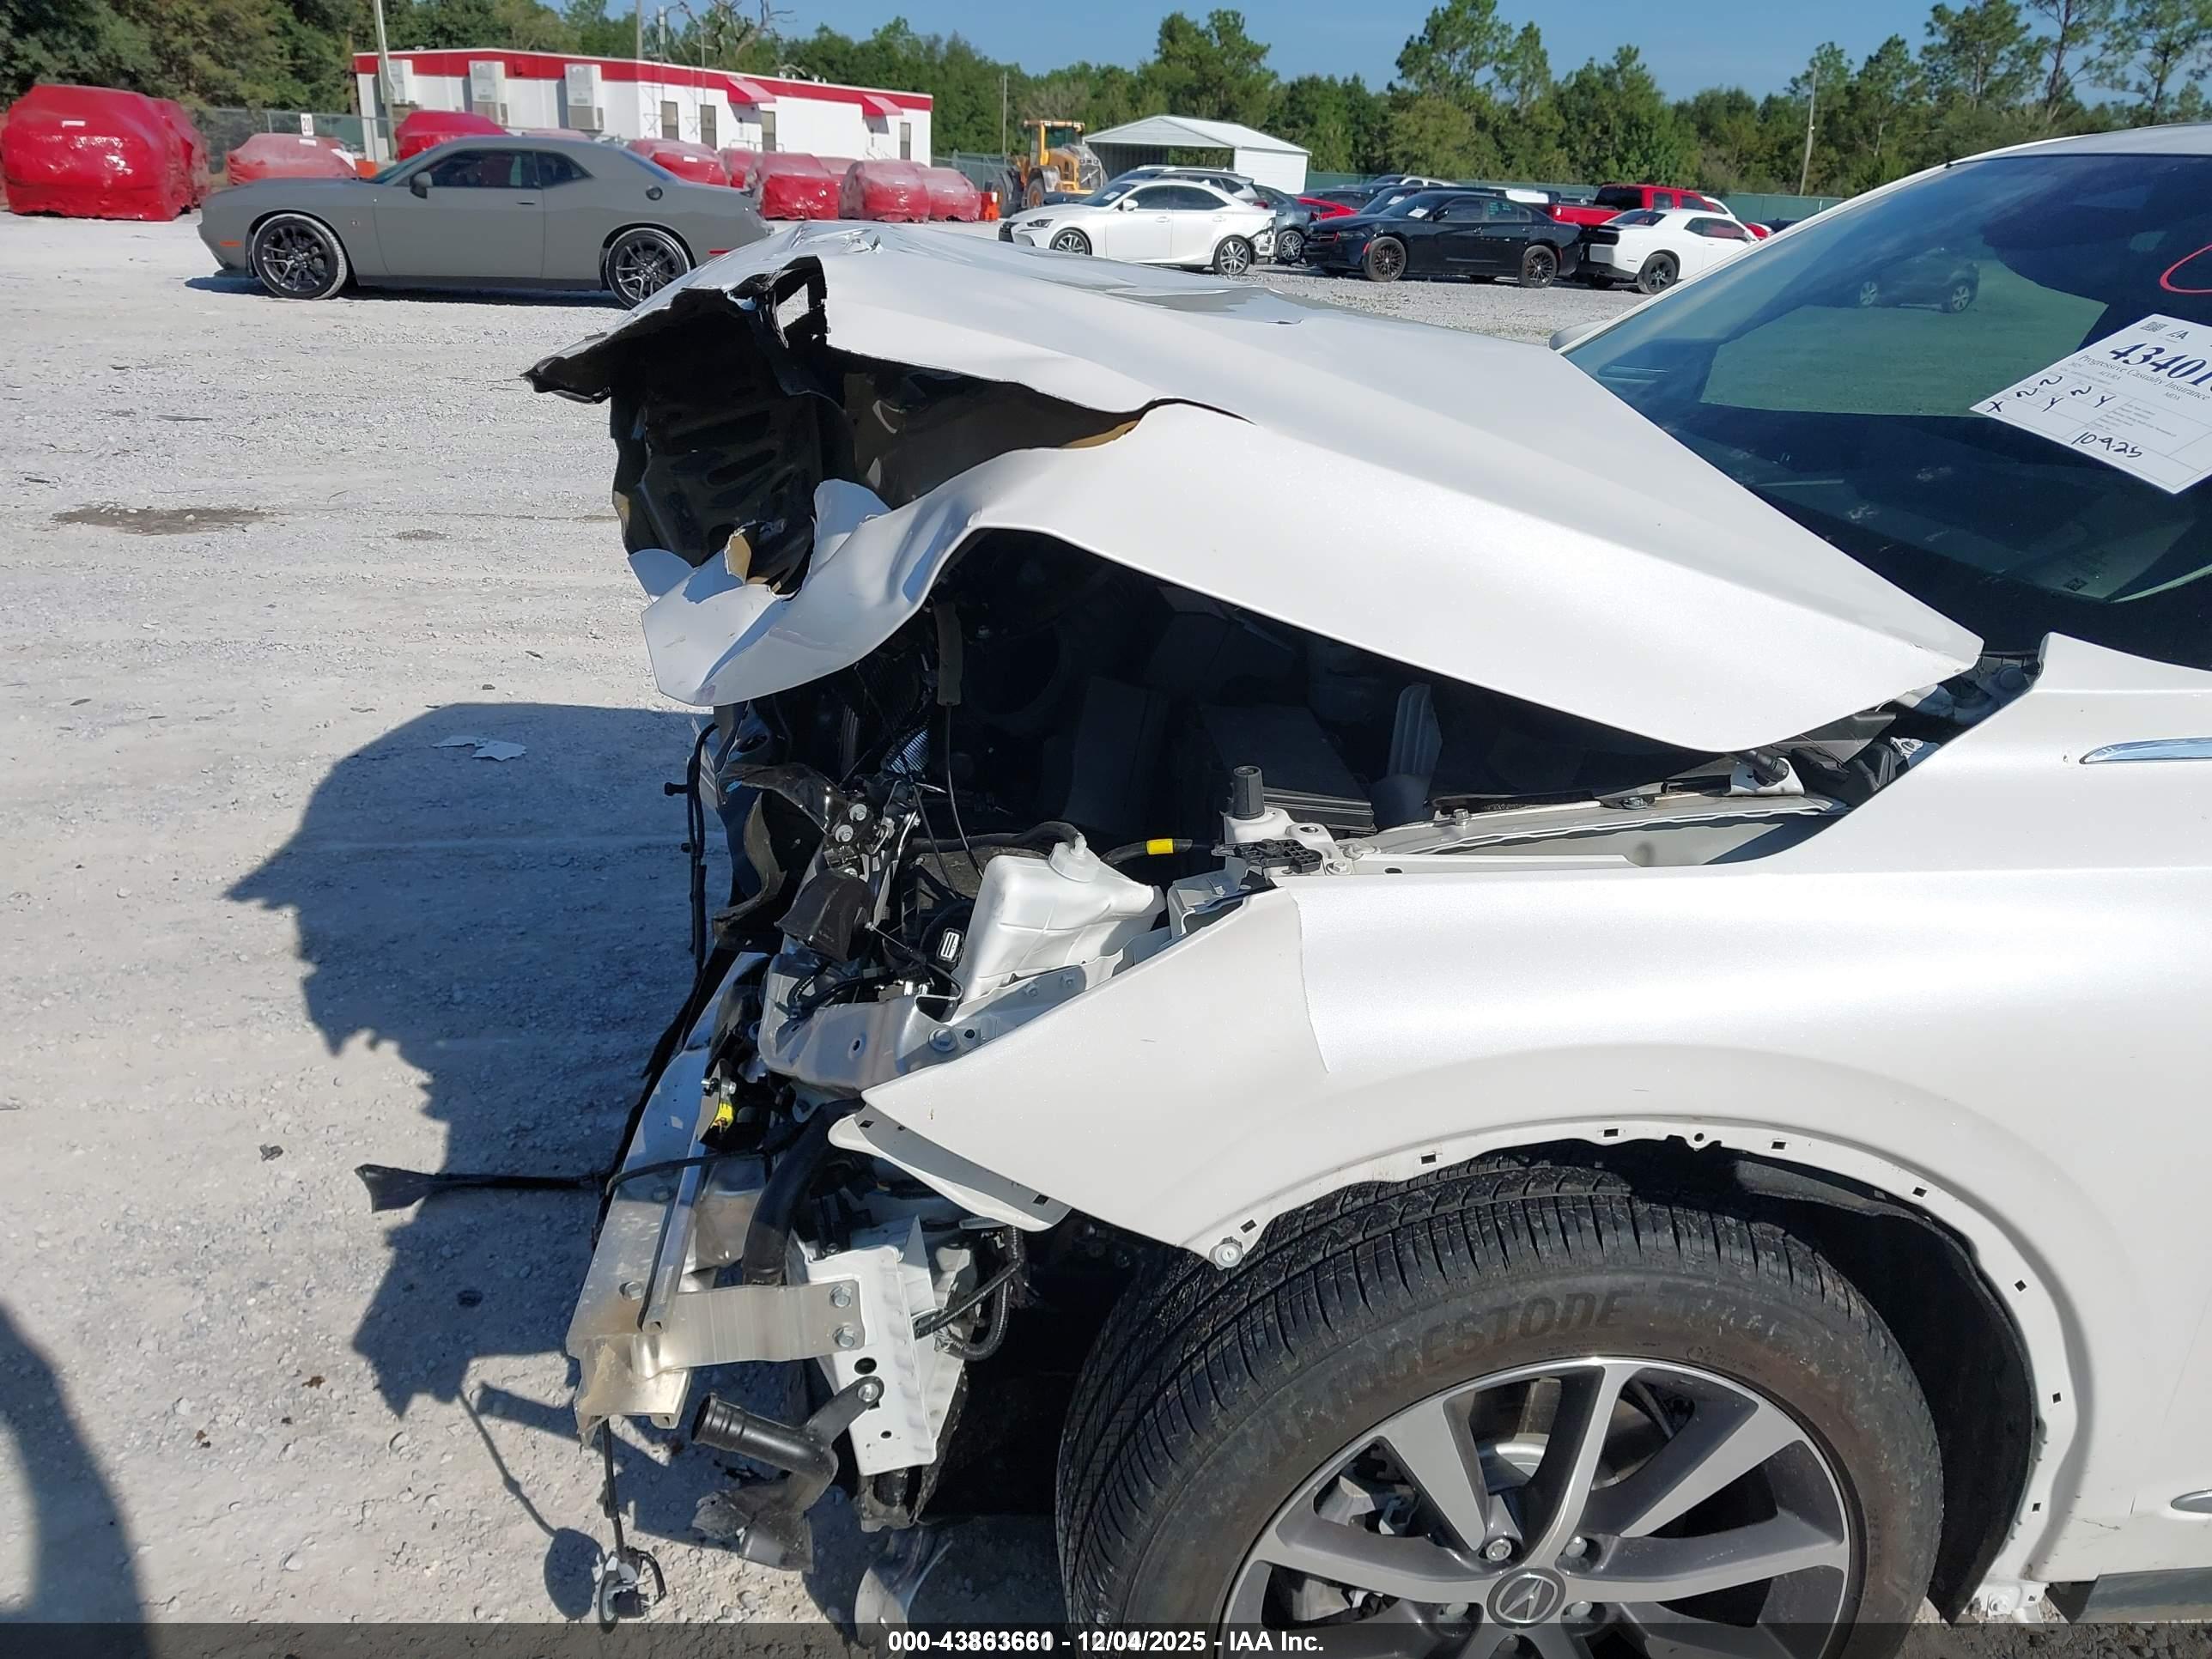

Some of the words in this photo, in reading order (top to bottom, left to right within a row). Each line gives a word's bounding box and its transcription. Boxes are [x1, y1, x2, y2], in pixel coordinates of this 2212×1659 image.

[2078, 355, 2127, 373] Progressive
[2126, 368, 2164, 386] Casualty
[2165, 381, 2212, 400] Insurance
[2108, 343, 2212, 392] 43401
